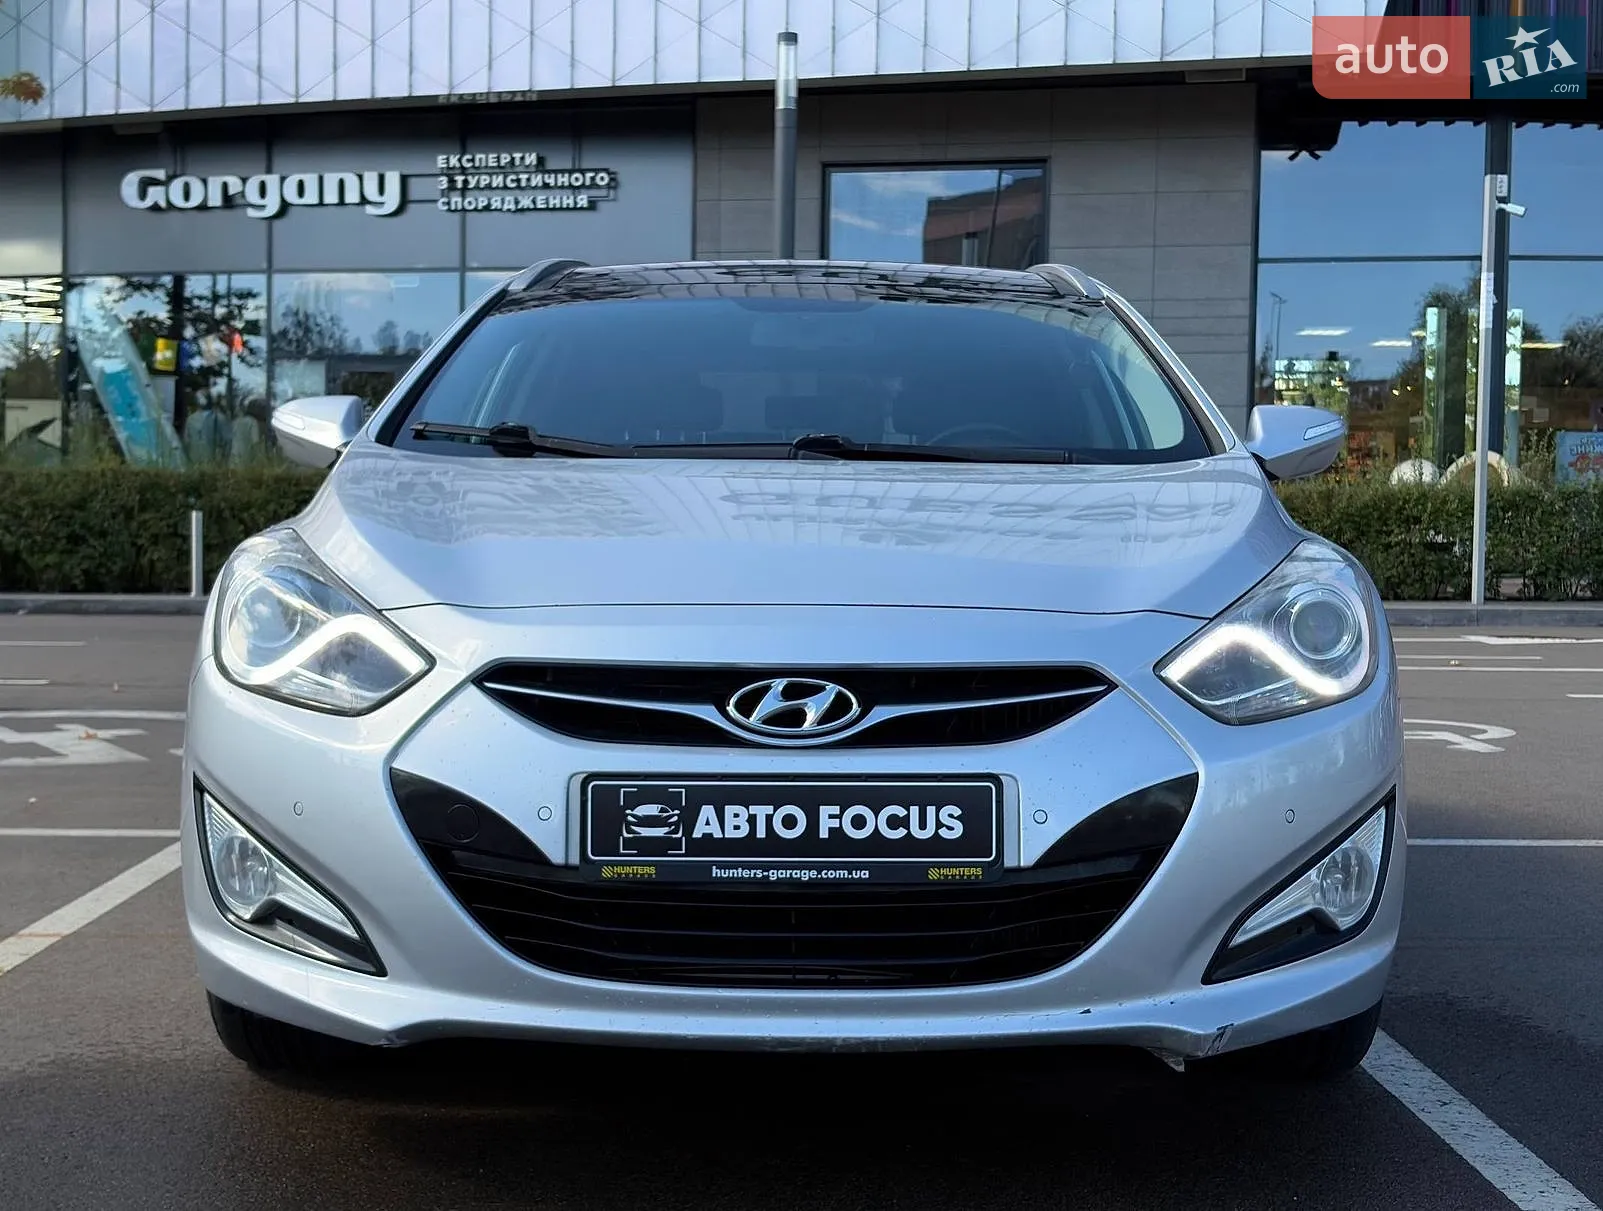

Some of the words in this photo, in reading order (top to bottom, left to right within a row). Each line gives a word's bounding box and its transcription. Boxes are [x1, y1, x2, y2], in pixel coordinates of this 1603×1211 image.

[436, 152, 538, 168] ЕКСПЕРТИ
[454, 172, 610, 189] ТУРИСТИЧНОГО
[120, 169, 401, 219] Gorgany
[436, 194, 588, 212] СПОРЯДЖЕННЯ
[692, 804, 807, 839] АВТО
[818, 804, 964, 839] FOCUS
[614, 866, 656, 874] HUNTERS
[712, 865, 870, 881] hunters-garage.com.ua
[940, 867, 983, 876] HUNTERS
